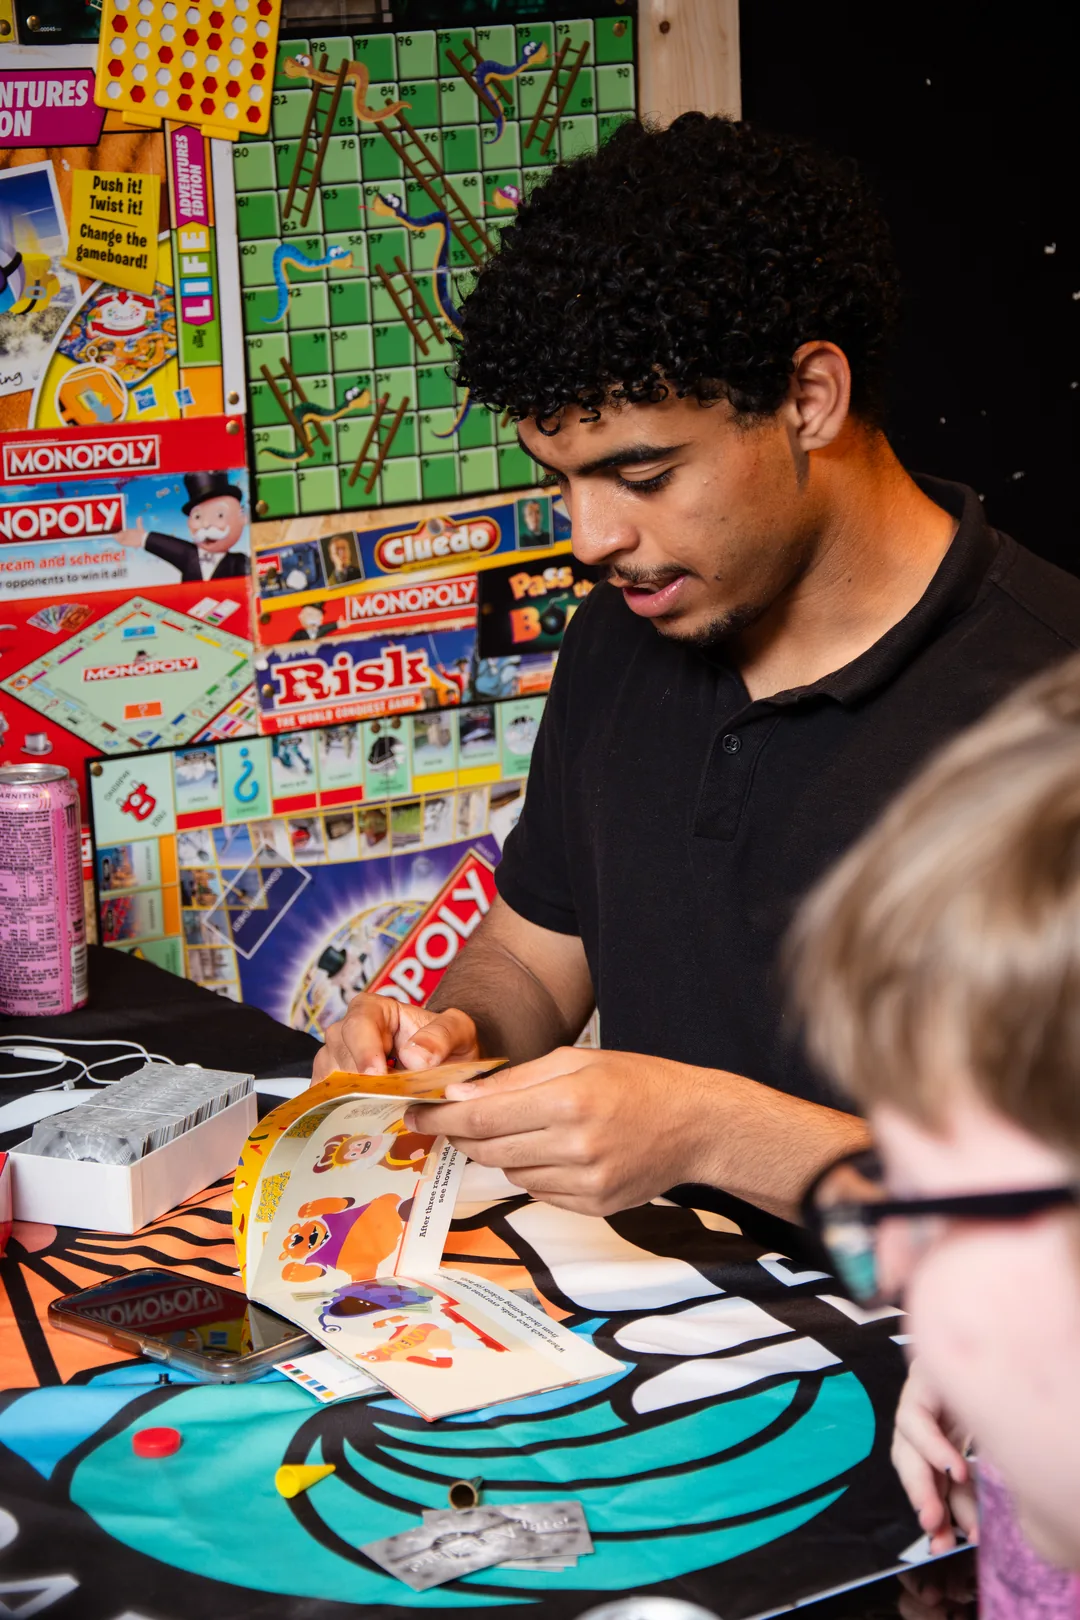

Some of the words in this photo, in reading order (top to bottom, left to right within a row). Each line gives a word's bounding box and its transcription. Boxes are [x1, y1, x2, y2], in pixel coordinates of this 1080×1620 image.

[477, 30, 491, 40] 94
[517, 27, 531, 38] 93
[556, 24, 570, 35] 92
[354, 39, 369, 50] 97
[398, 35, 413, 46] 96
[312, 42, 327, 53] 98
[616, 68, 630, 78] 90
[520, 75, 535, 86] 88
[380, 86, 395, 96] 84
[401, 85, 416, 96] 85
[440, 82, 455, 93] 86
[273, 95, 288, 105] 82
[581, 97, 593, 108] 89
[339, 116, 354, 127] 83
[561, 120, 573, 131] 72
[424, 132, 438, 142] 76
[443, 130, 457, 141] 75
[483, 127, 496, 138] 74
[340, 139, 355, 150] 78
[361, 138, 376, 149] 77
[234, 148, 249, 158] 80
[275, 144, 290, 155] 79
[175, 134, 192, 218] ADVENTURES
[485, 175, 499, 185] 67
[93, 175, 123, 194] Push
[127, 177, 142, 195] it!
[463, 177, 477, 187] 66
[190, 164, 204, 217] EDITION
[323, 189, 338, 199] 63
[90, 195, 124, 213] Twist
[128, 198, 143, 216] it!
[238, 197, 249, 207] 61
[283, 221, 297, 231] 62
[80, 224, 123, 248] Change
[126, 231, 147, 247] the
[369, 234, 383, 243] 57
[412, 229, 426, 239] 56
[306, 239, 319, 249] 59
[348, 235, 363, 245] 58
[242, 245, 257, 255] 60
[76, 244, 148, 270] gameboard!
[181, 231, 211, 318] LIFE
[329, 284, 344, 294] 43
[375, 327, 388, 337] 37
[248, 338, 263, 348] 40
[377, 373, 391, 382] 24
[418, 369, 432, 378] 25
[314, 380, 328, 389] 22
[357, 375, 370, 385] 23
[251, 386, 263, 395] 21
[255, 433, 269, 442] 20
[10, 440, 154, 474] MONOPOLY
[384, 524, 489, 565] Cluedo
[39, 553, 66, 569] and
[70, 549, 126, 566] scheme!
[6, 573, 65, 591] opponents
[66, 572, 79, 582] to
[81, 571, 98, 581] win
[101, 569, 109, 579] it
[352, 581, 475, 618] MONOPOLY
[86, 657, 196, 681] MONOPOLY
[276, 650, 427, 706] Risk
[276, 716, 295, 728] THE
[298, 709, 333, 724] WORLD
[335, 701, 385, 718] CONQUEST
[388, 696, 416, 710] GAME
[419, 1214, 430, 1238] After
[425, 1186, 437, 1213] three
[432, 1160, 446, 1185] races,
[441, 1144, 451, 1161] add
[438, 1188, 447, 1204] see
[443, 1167, 453, 1187] how
[471, 1288, 500, 1309] everyone
[501, 1306, 517, 1320] ends,
[504, 1301, 527, 1317] betting
[516, 1318, 532, 1330] race
[526, 1315, 542, 1327] their
[531, 1328, 548, 1341] each
[542, 1326, 559, 1338] from
[547, 1339, 565, 1353] When
